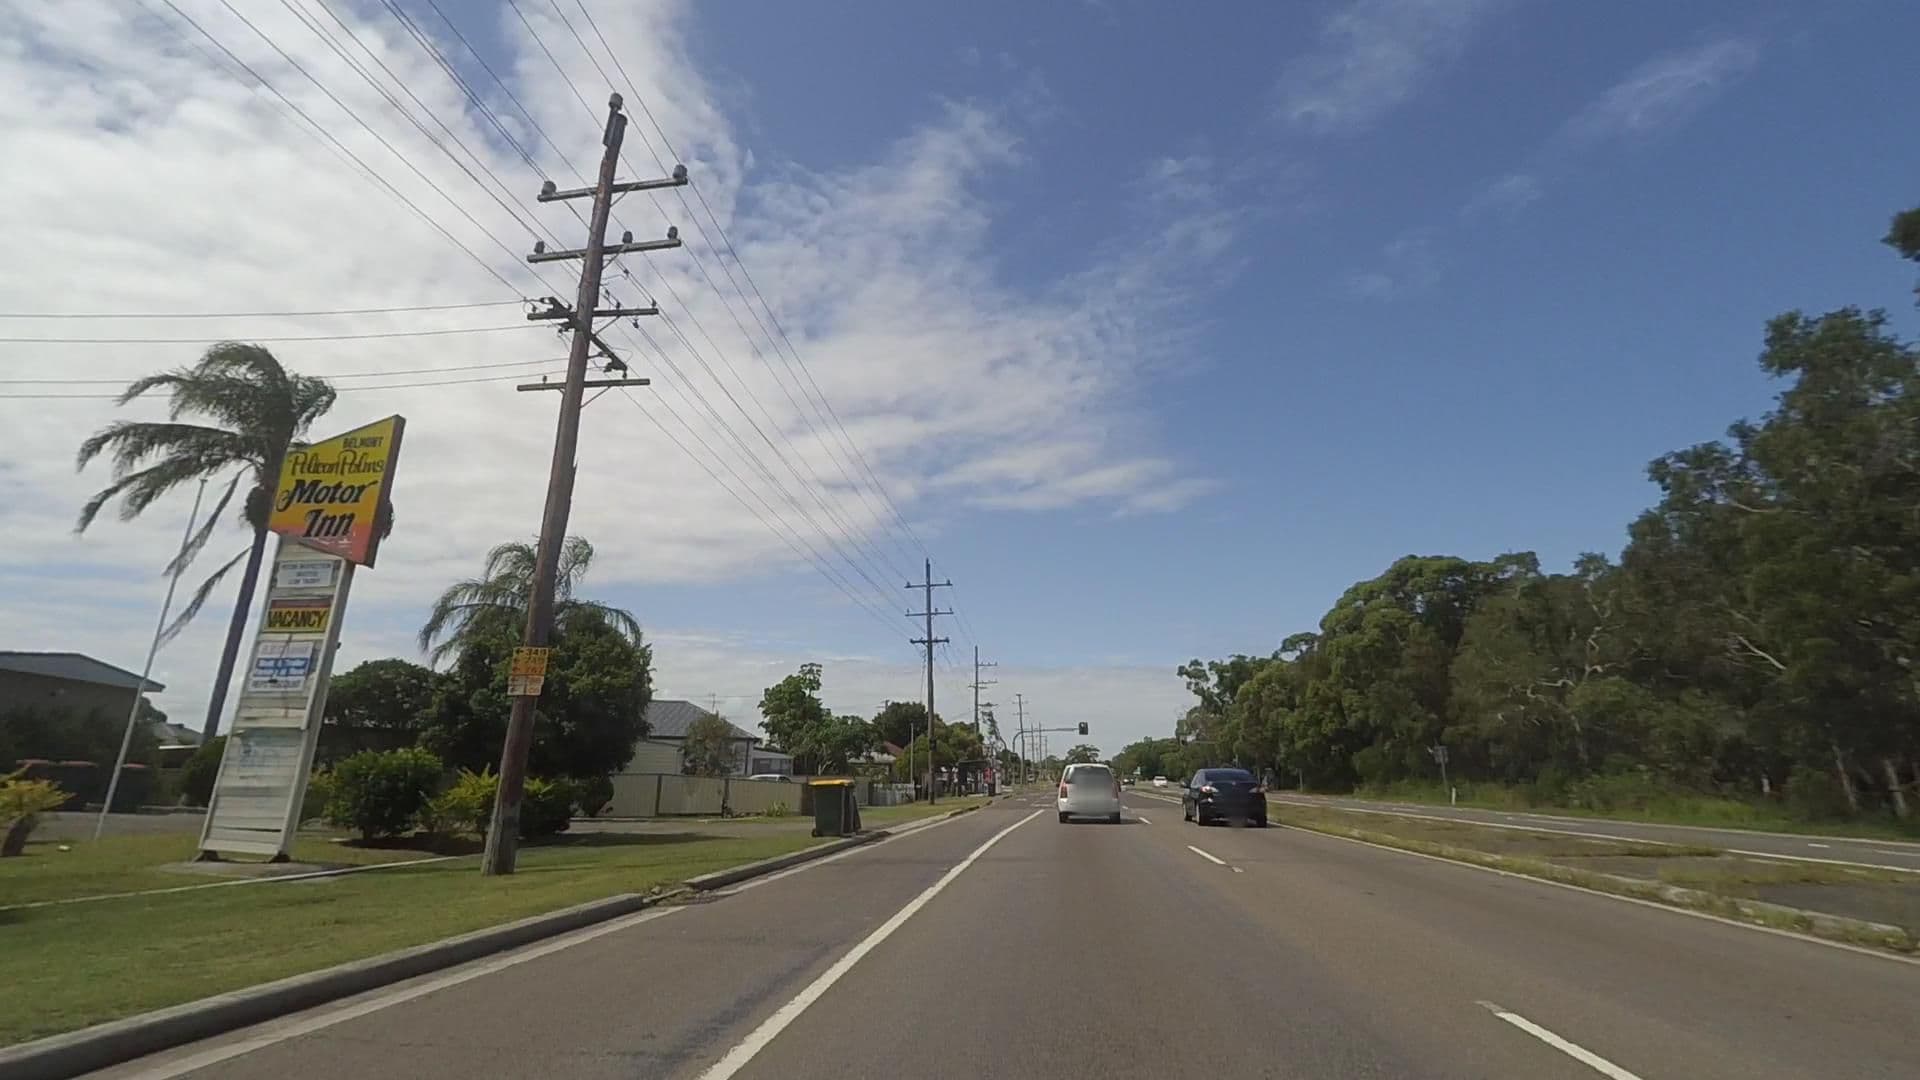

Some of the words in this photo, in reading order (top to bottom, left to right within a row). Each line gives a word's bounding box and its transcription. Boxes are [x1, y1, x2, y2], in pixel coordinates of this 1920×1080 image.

[342, 436, 384, 449] BELMONT
[338, 449, 386, 476] Palms
[276, 479, 378, 512] Motor
[303, 508, 356, 538] Inn
[268, 610, 328, 628] VACANCY
